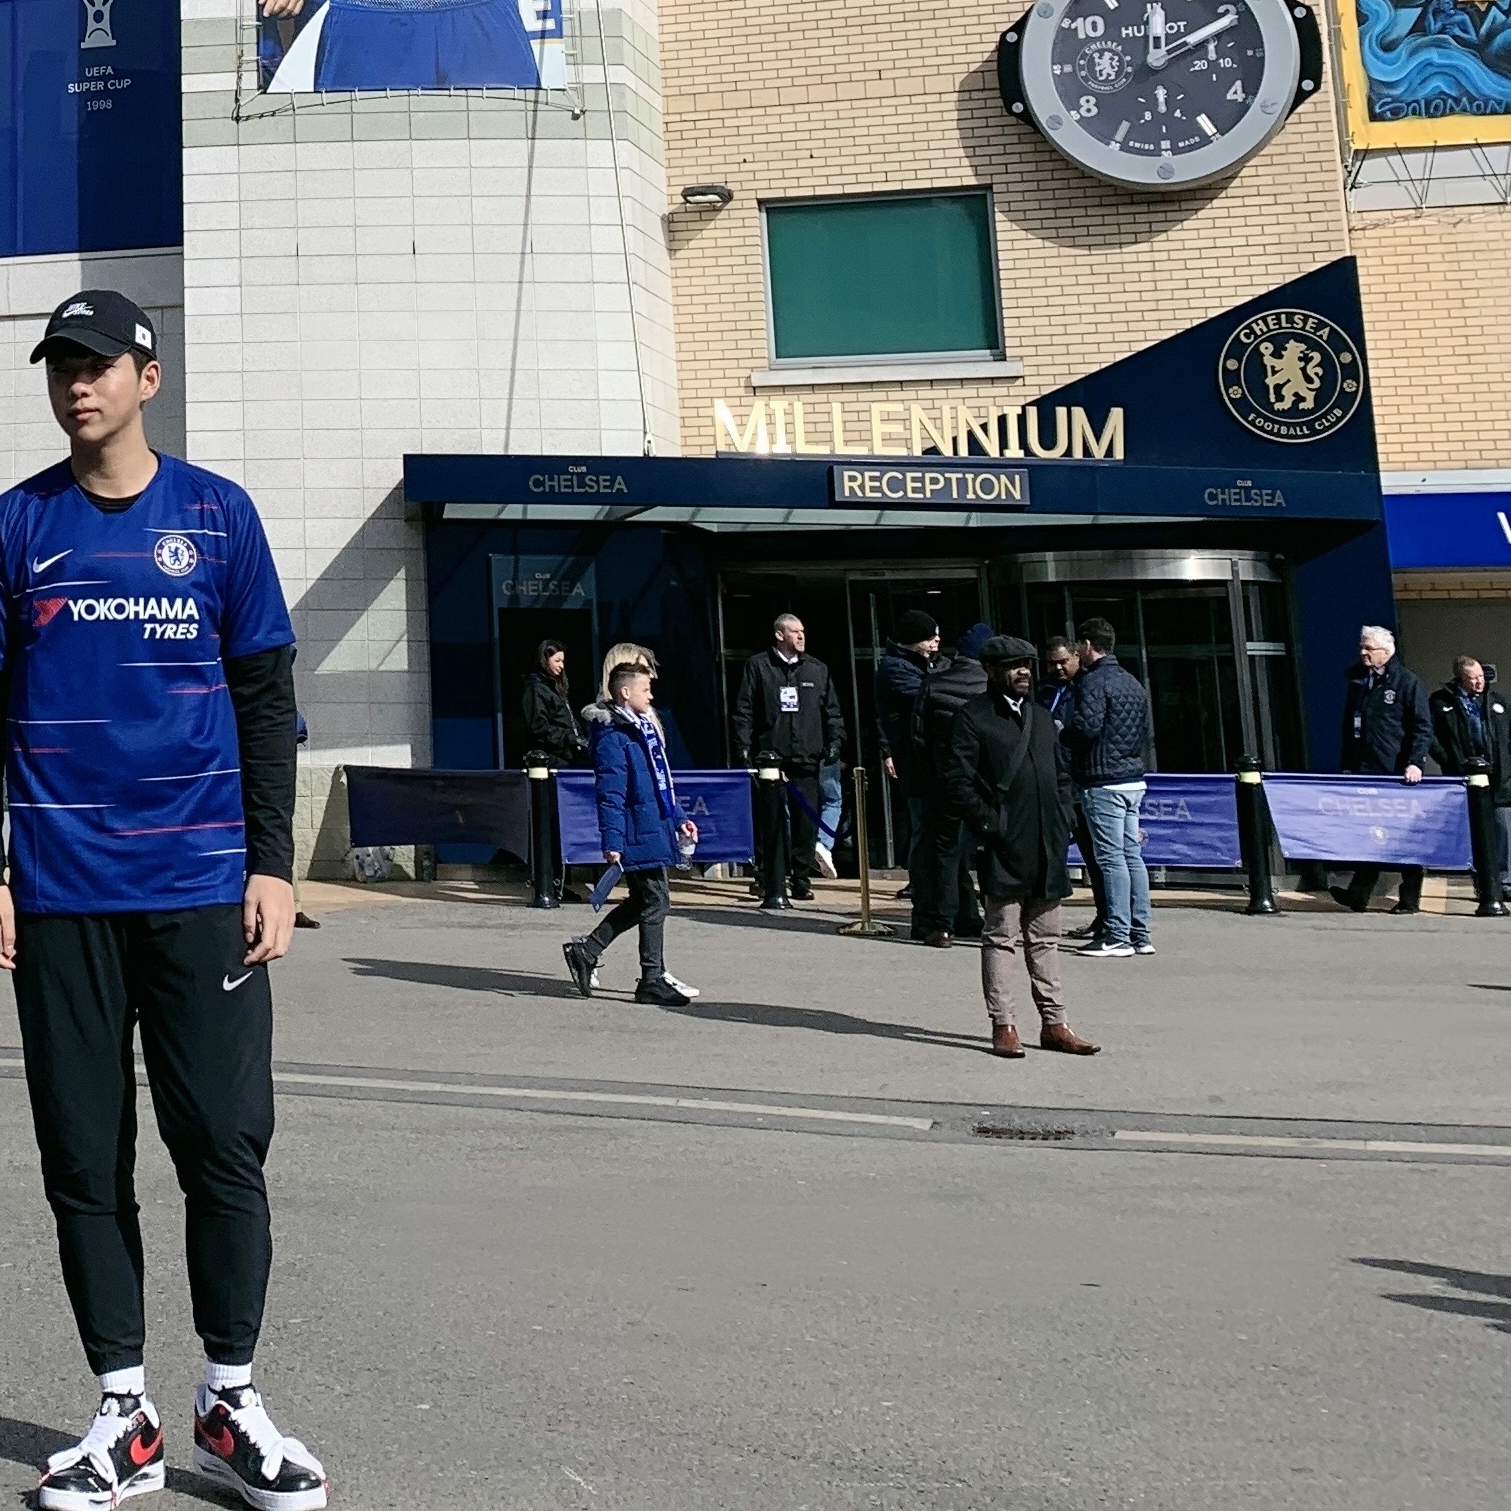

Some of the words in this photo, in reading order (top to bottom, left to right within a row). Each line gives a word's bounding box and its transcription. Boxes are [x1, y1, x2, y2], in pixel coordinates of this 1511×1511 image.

[1071, 15, 1105, 39] 10
[1121, 21, 1187, 38] HUOT
[1085, 41, 1122, 54] CHELSEA
[85, 65, 114, 78] UEFA
[1193, 60, 1207, 70] 20
[1218, 58, 1232, 67] 10
[67, 80, 105, 93] SUPER
[107, 78, 132, 90] CUP
[1227, 80, 1246, 102] 4
[86, 99, 113, 111] 1998
[1079, 95, 1098, 117] 8
[1240, 314, 1331, 344] CHELSEA
[713, 398, 1125, 460] MILLENNIUM
[1247, 413, 1310, 435] FOOTBALL
[1315, 408, 1343, 429] CLUB
[568, 465, 587, 473] CLUB
[528, 474, 628, 493] CHELSEA
[843, 471, 1022, 500] RECEPTION
[1204, 488, 1287, 507] CHELSEA
[502, 579, 585, 597] CHELSEA
[67, 597, 199, 621] YOKOHAMA
[143, 623, 199, 639] TYRES
[1317, 797, 1426, 819] CHELSEA
